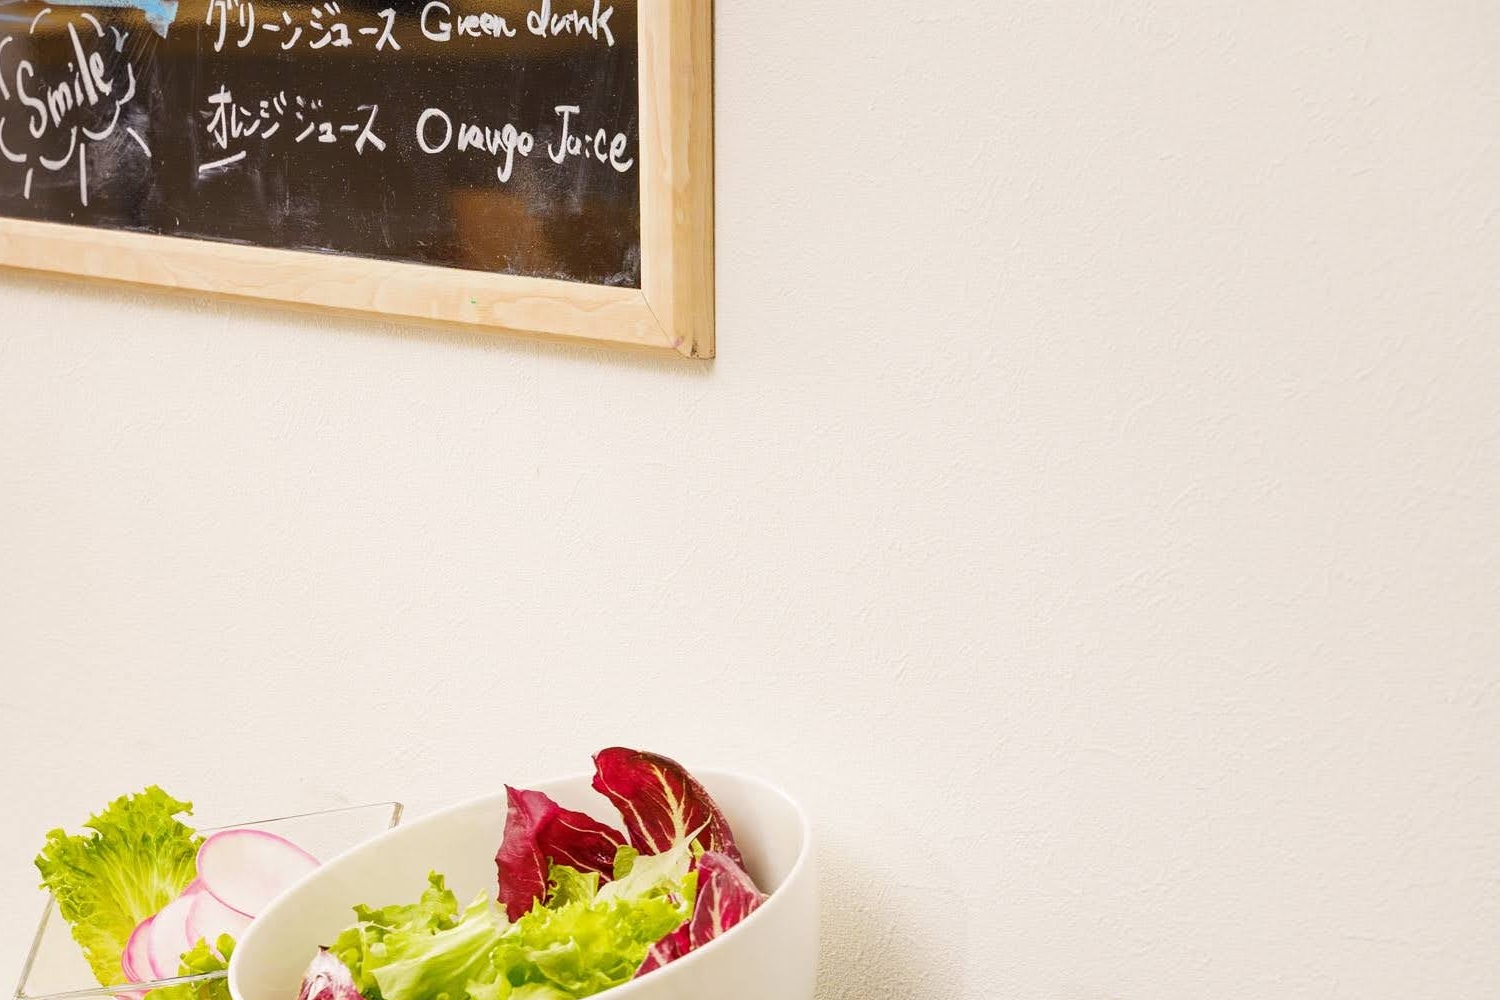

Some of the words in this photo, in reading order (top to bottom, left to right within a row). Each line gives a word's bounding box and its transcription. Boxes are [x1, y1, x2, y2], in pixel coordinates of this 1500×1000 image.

[206, 0, 401, 52] グリーンジュース
[420, 1, 517, 42] Green
[16, 22, 115, 139] Smile
[205, 84, 387, 155] オレンジジュース
